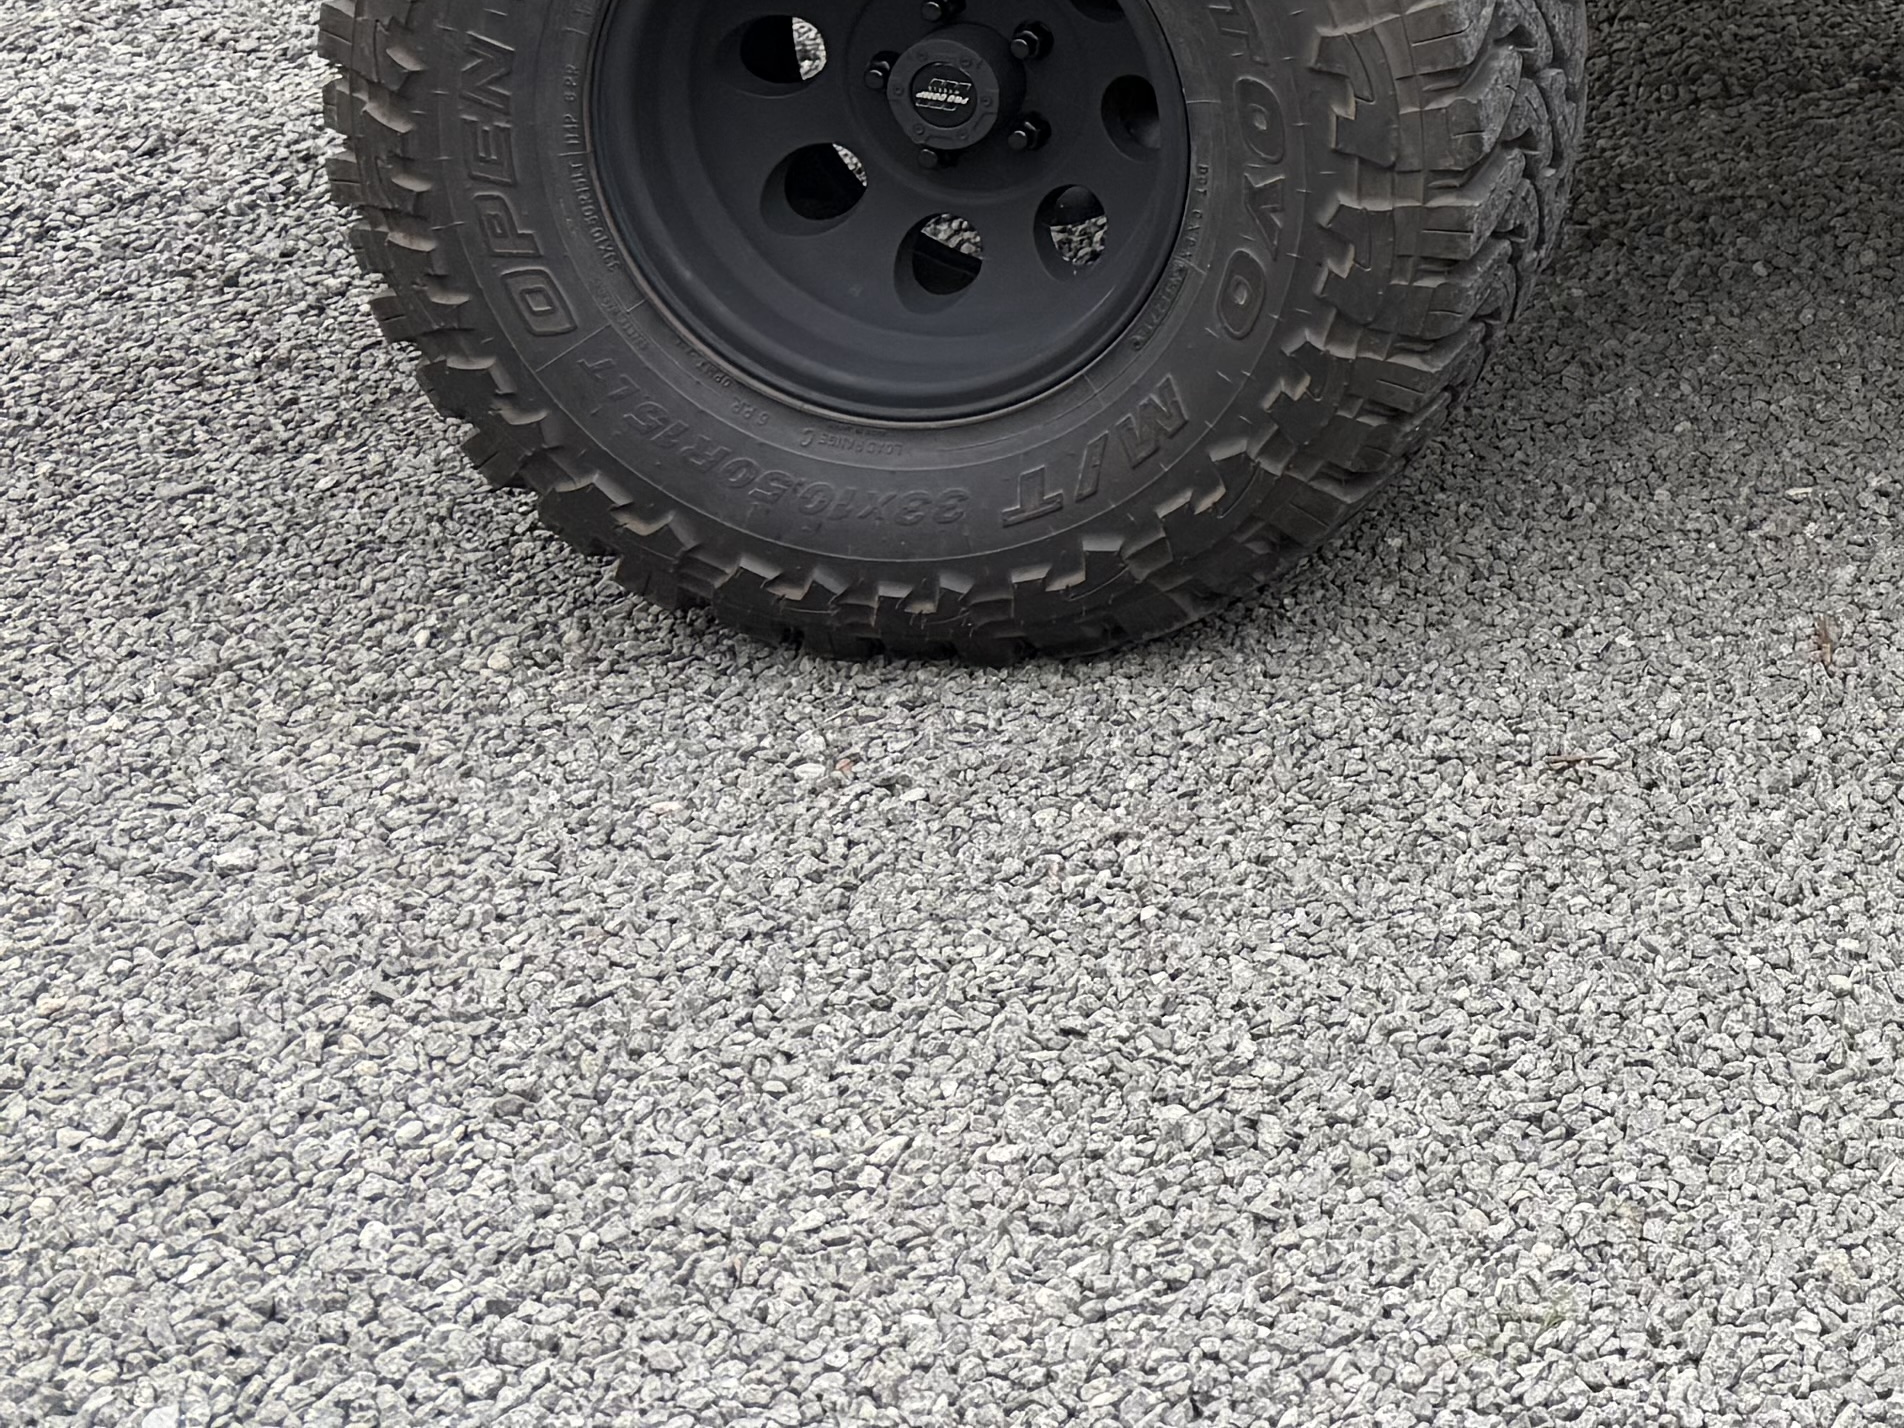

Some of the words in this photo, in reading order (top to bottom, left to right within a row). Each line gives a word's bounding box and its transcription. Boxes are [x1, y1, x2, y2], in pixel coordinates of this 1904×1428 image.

[459, 30, 578, 336] OPEN
[800, 427, 816, 448] C
[1001, 370, 1191, 528] M/T
